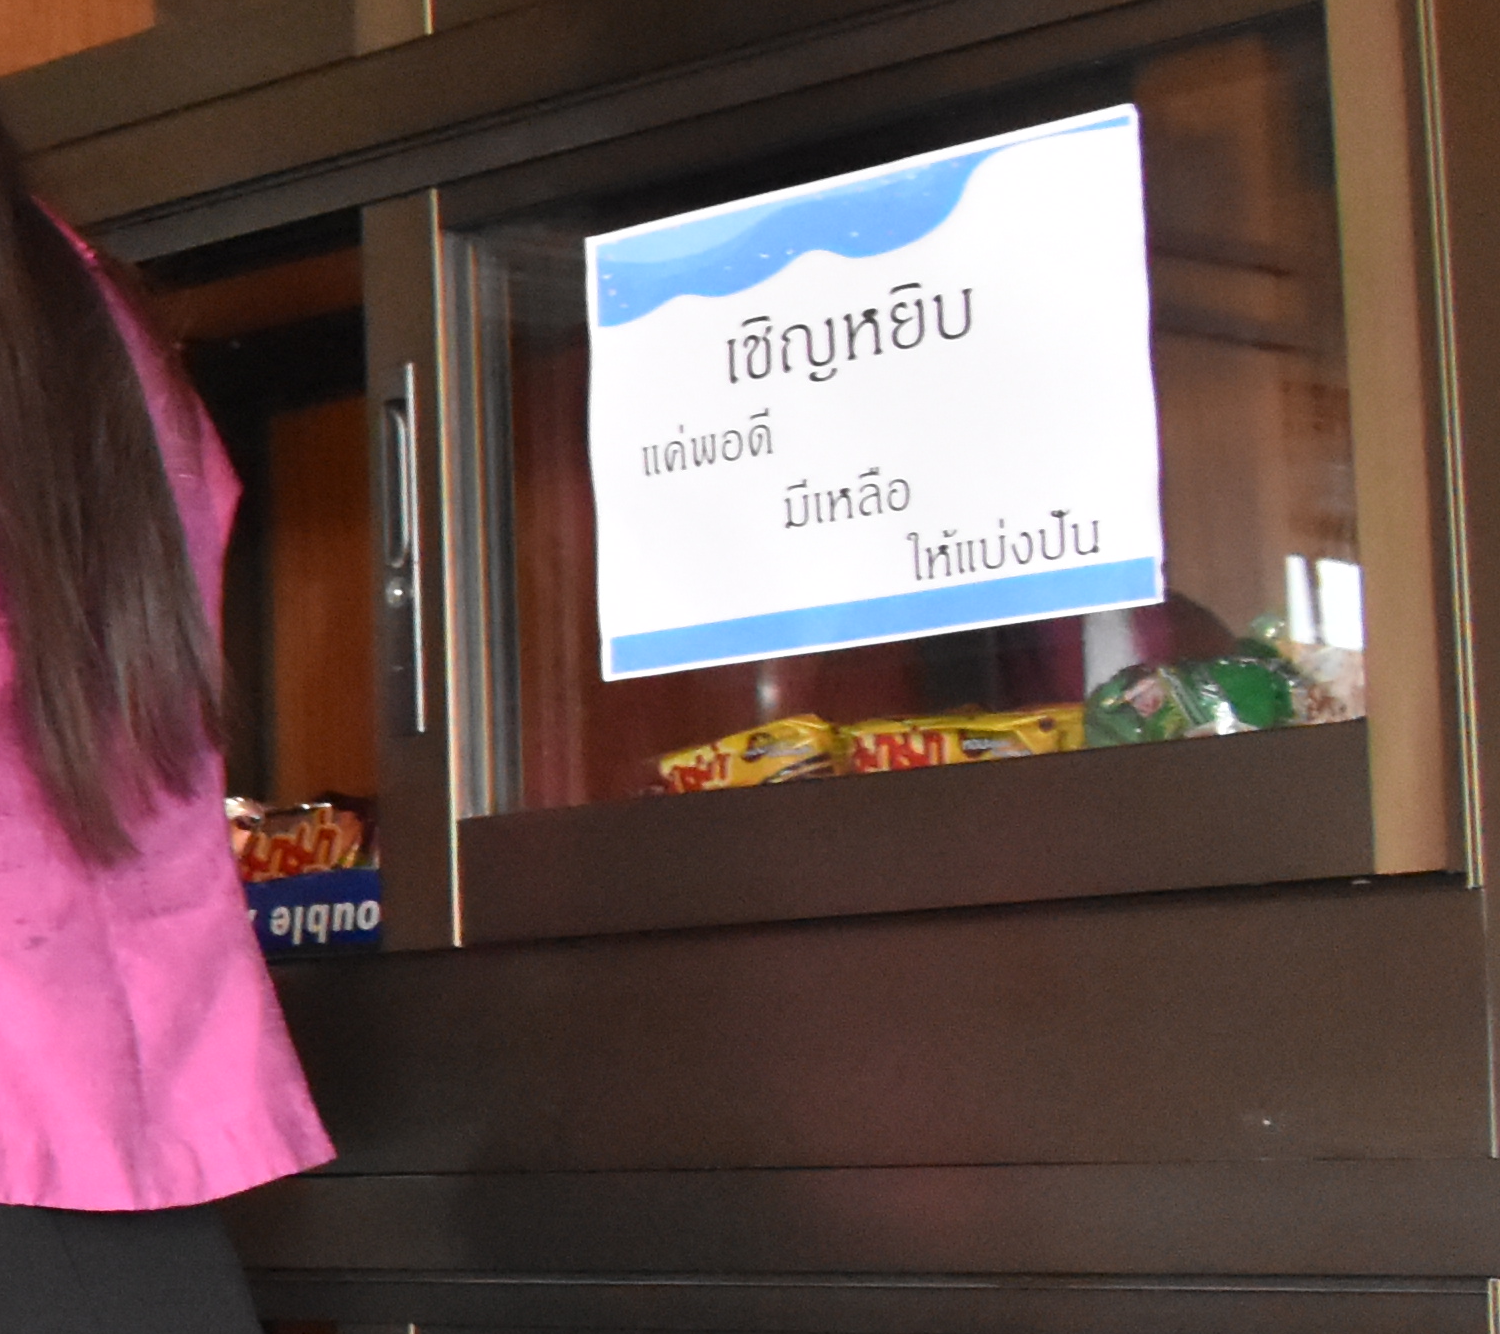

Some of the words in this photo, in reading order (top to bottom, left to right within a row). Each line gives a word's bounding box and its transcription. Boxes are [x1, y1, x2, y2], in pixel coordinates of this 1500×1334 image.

[725, 282, 974, 384] เชิญหยิบ
[641, 407, 775, 478] แค่พอดี
[782, 466, 913, 531] มีเหลือ
[906, 508, 1102, 583] ให้แบ่งปัน
[269, 899, 381, 946] ouble
